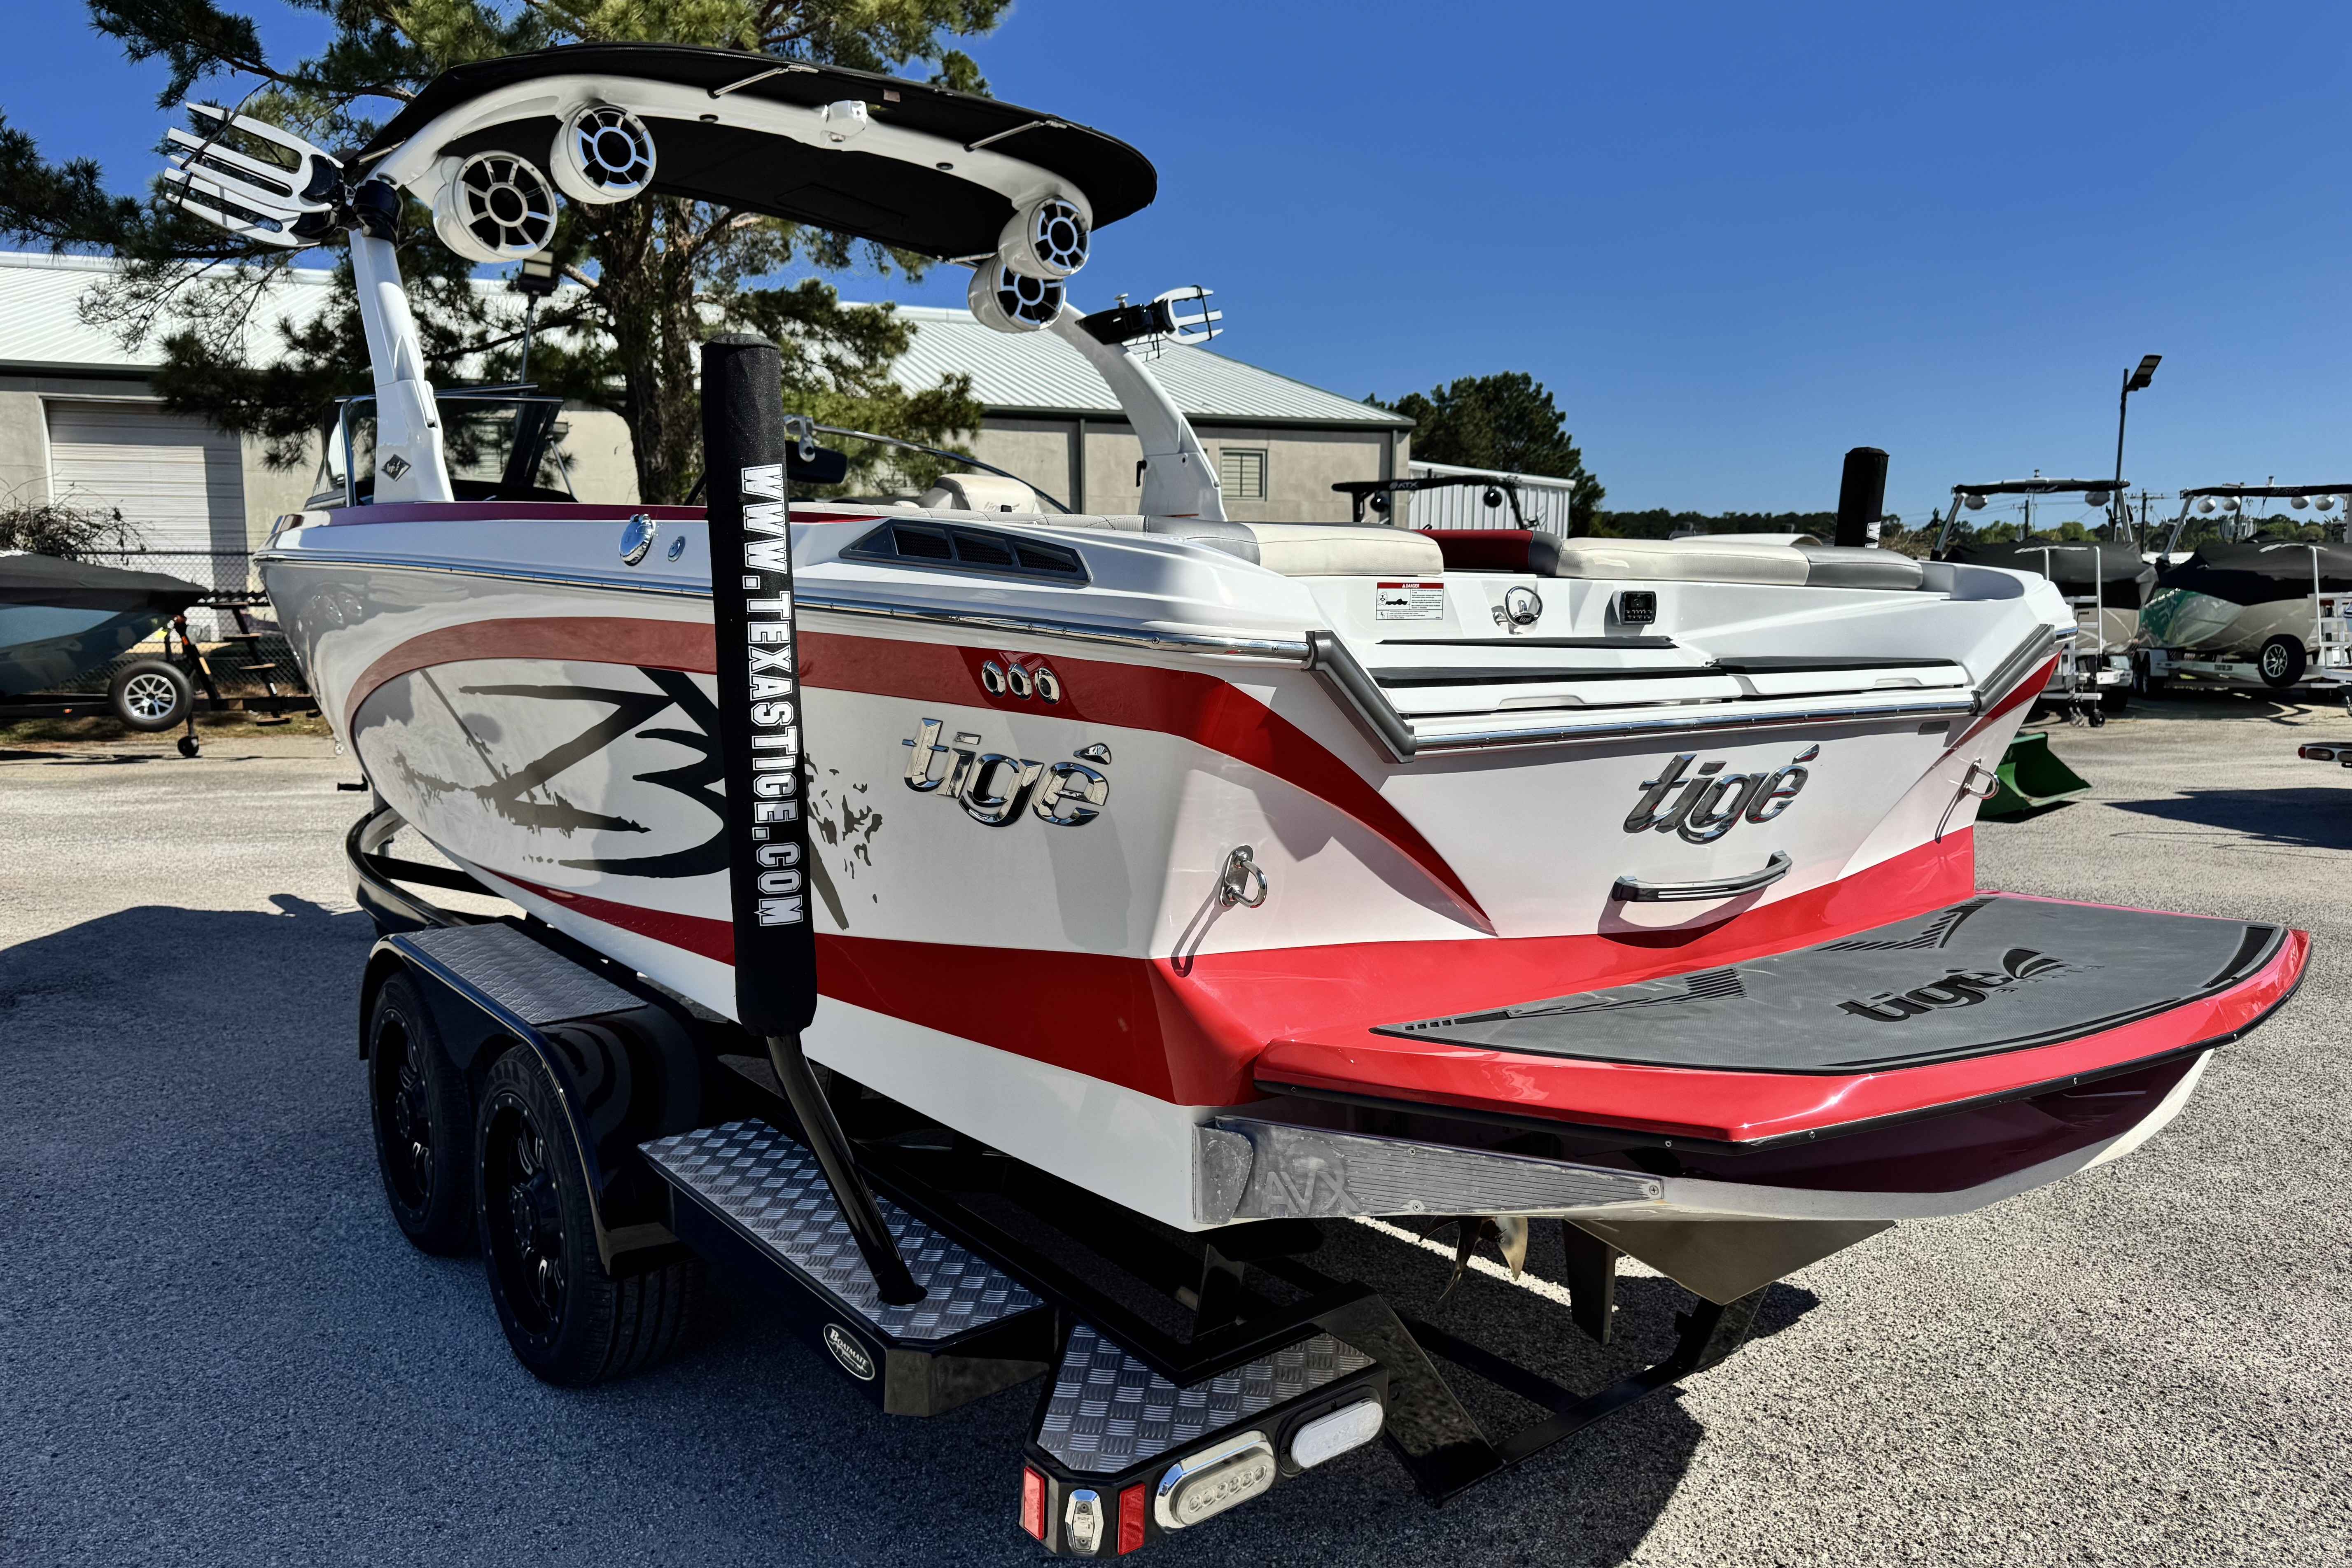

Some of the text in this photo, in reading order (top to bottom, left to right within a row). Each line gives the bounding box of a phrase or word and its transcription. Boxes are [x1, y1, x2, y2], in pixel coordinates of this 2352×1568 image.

[742, 464, 803, 926] WWW.TEXASTIGE.COM
[902, 718, 1112, 828] tigé
[1622, 744, 1820, 845] tigé
[1836, 968, 2014, 1022] tigé
